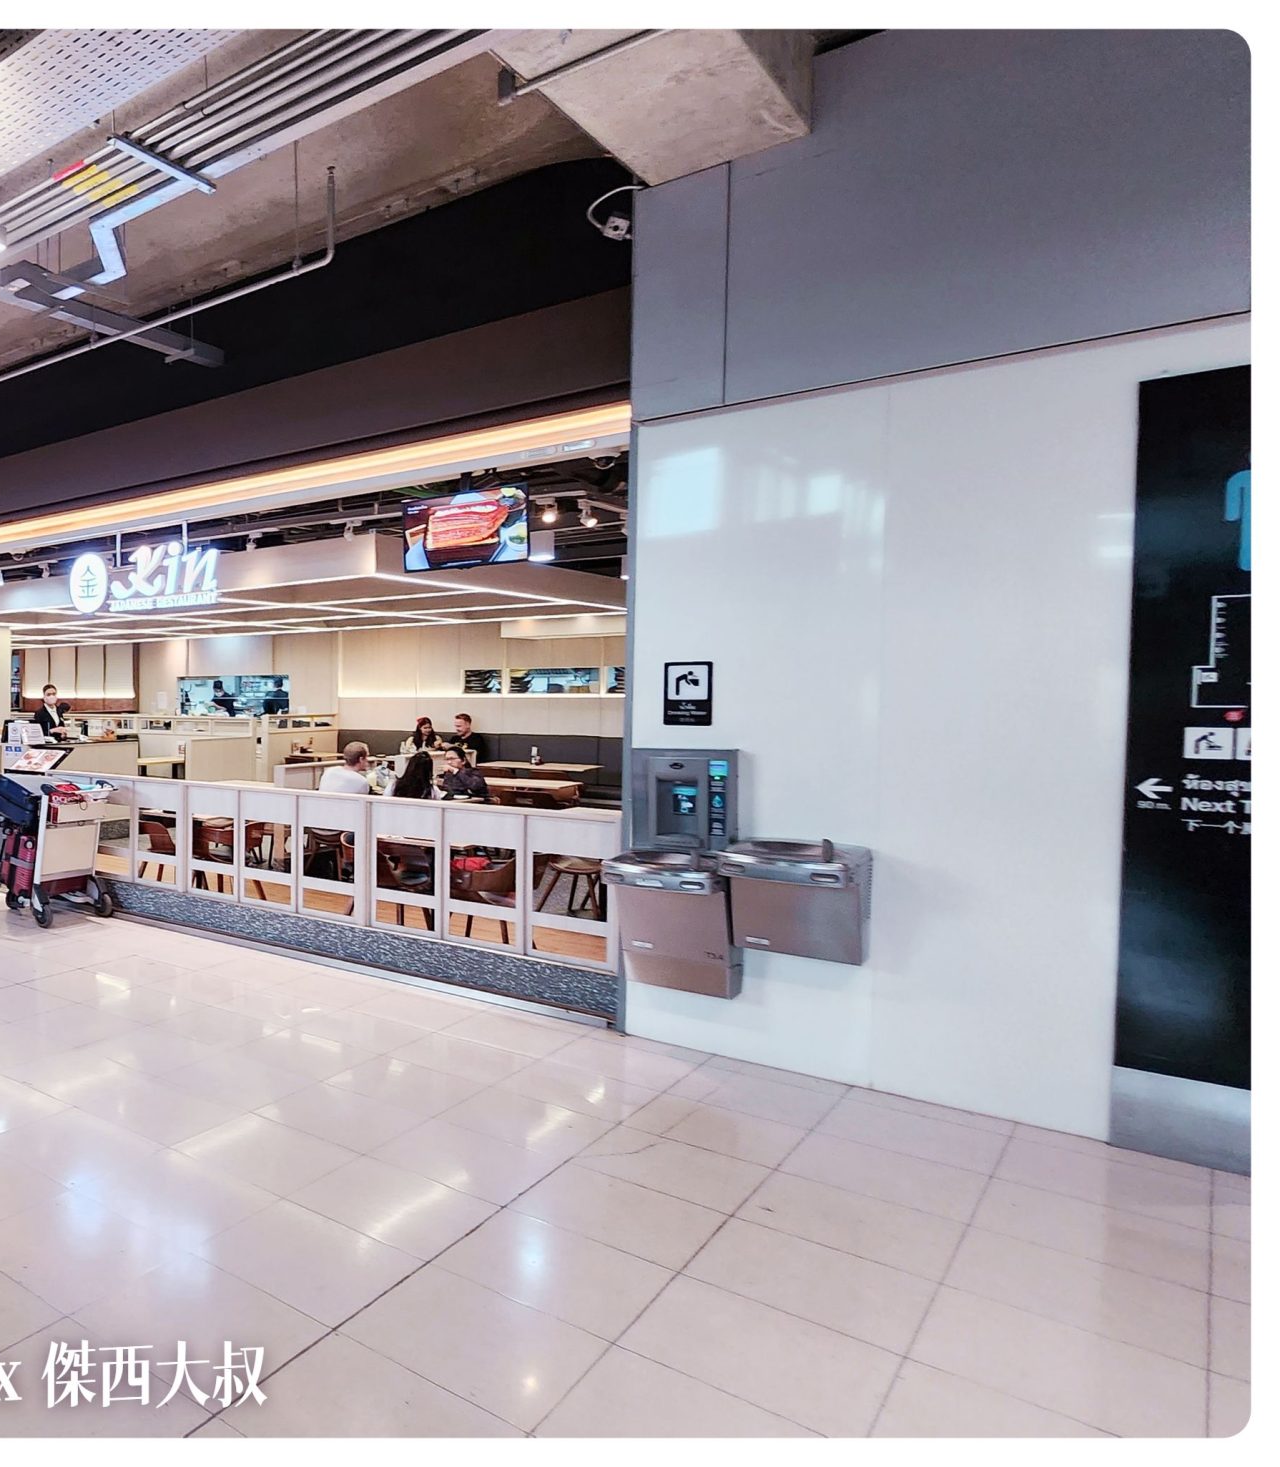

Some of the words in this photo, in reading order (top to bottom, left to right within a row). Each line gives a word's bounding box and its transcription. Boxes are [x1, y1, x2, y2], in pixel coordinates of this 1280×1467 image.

[78, 564, 98, 599] 金
[110, 540, 220, 599] Kin
[1180, 797, 1237, 814] Next
